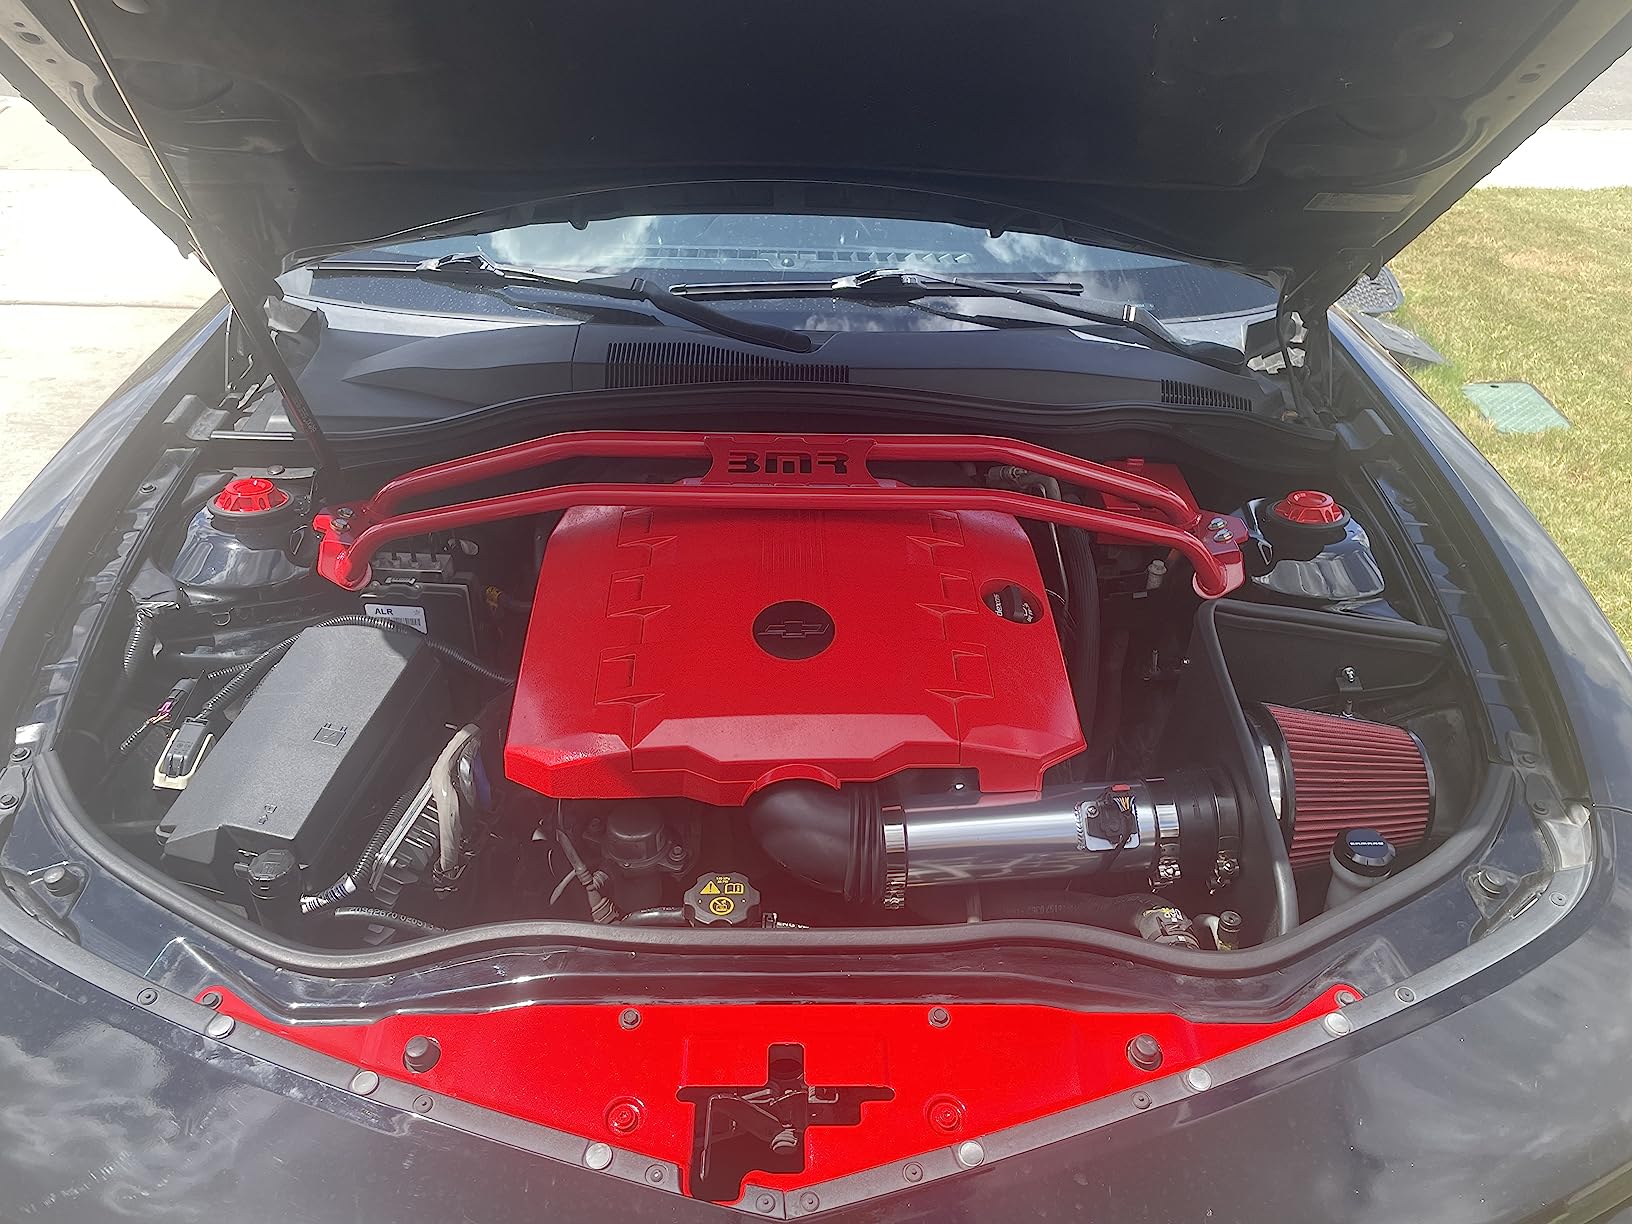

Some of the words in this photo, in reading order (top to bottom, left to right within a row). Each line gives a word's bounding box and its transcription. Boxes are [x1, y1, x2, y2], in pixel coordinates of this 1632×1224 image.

[728, 451, 849, 474] BMR
[375, 607, 394, 616] ALR
[993, 593, 1003, 617] dexos
